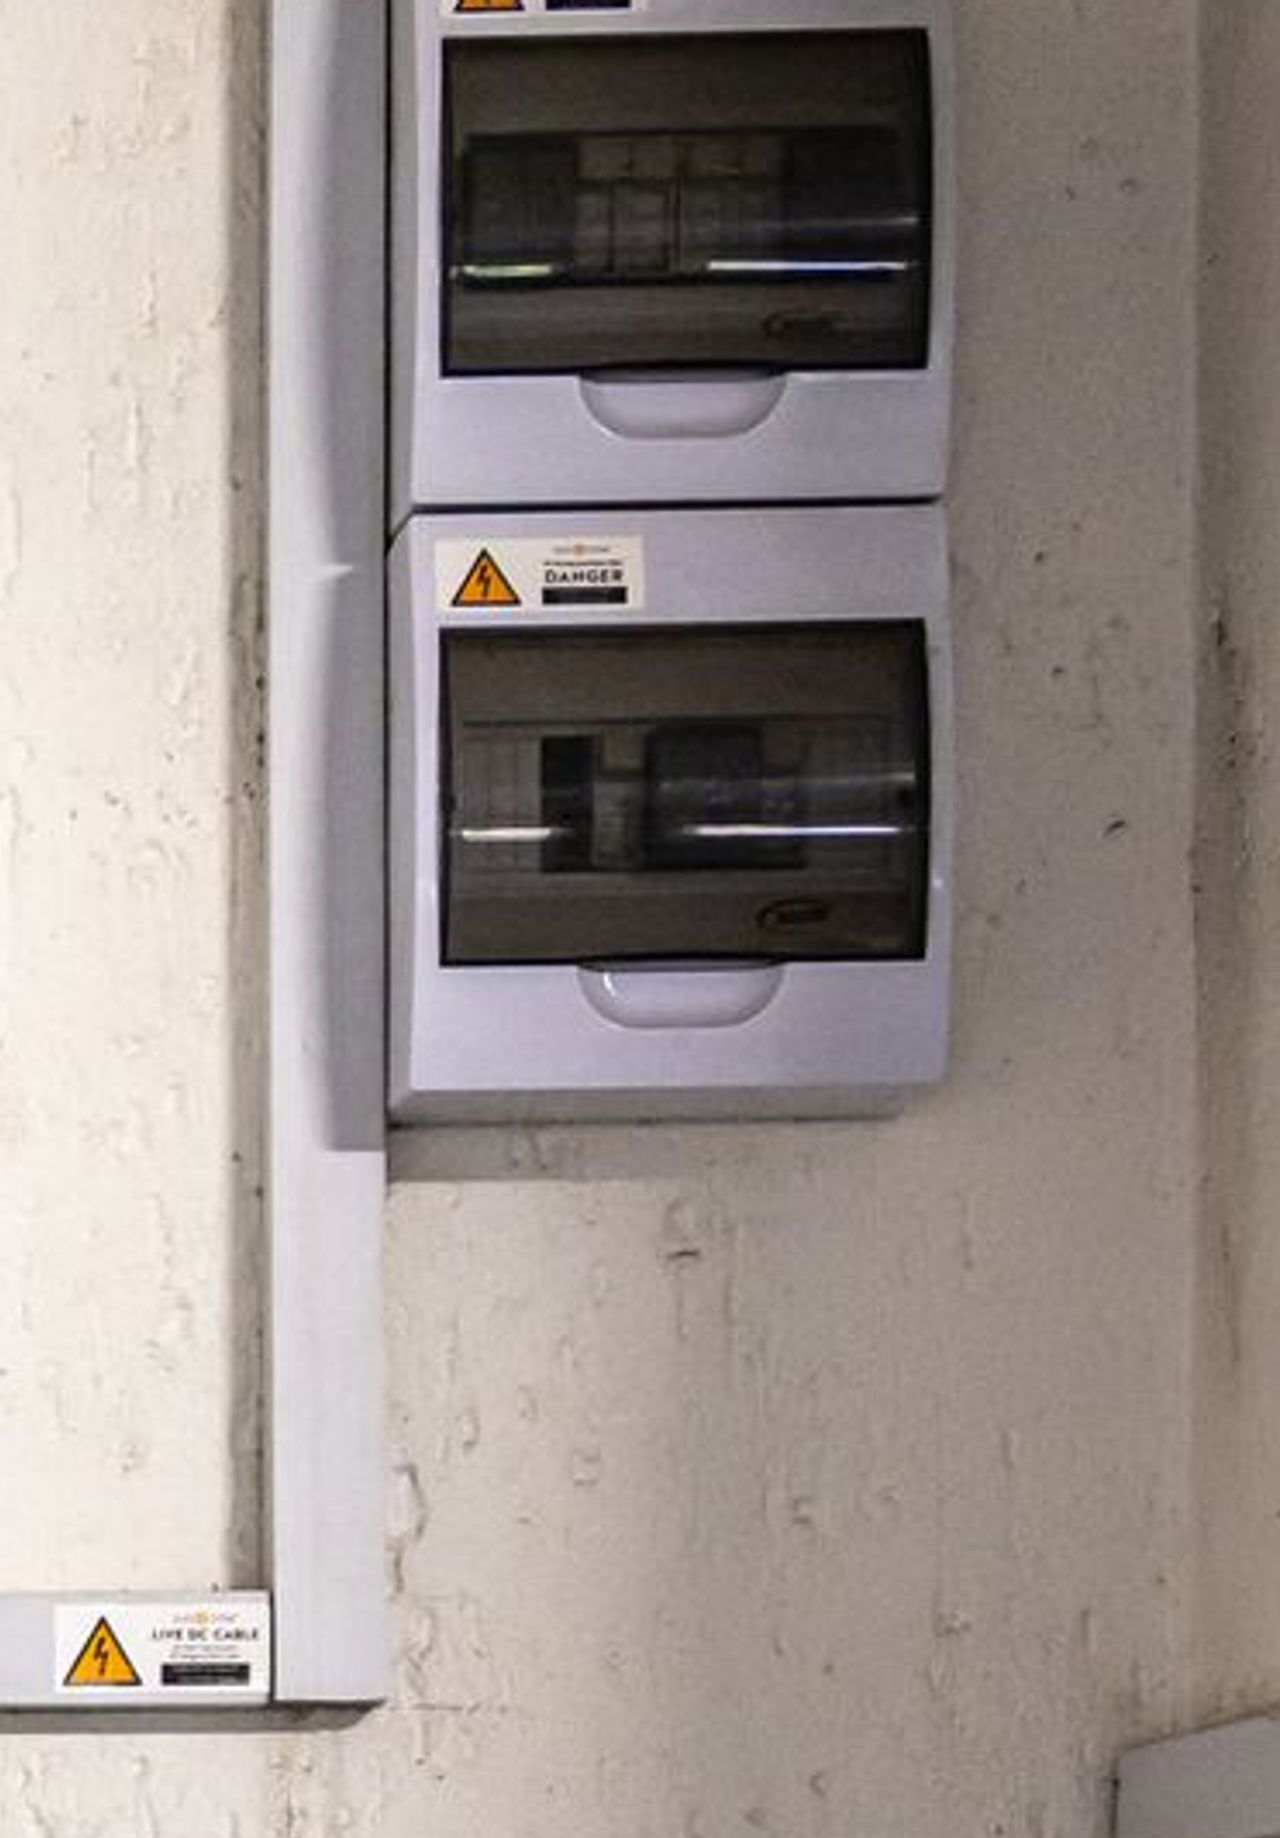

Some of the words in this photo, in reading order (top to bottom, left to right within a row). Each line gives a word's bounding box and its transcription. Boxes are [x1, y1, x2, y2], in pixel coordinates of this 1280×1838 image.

[545, 569, 623, 583] DANGER
[151, 1628, 183, 1641] LIVE
[212, 1628, 259, 1641] CABLE
